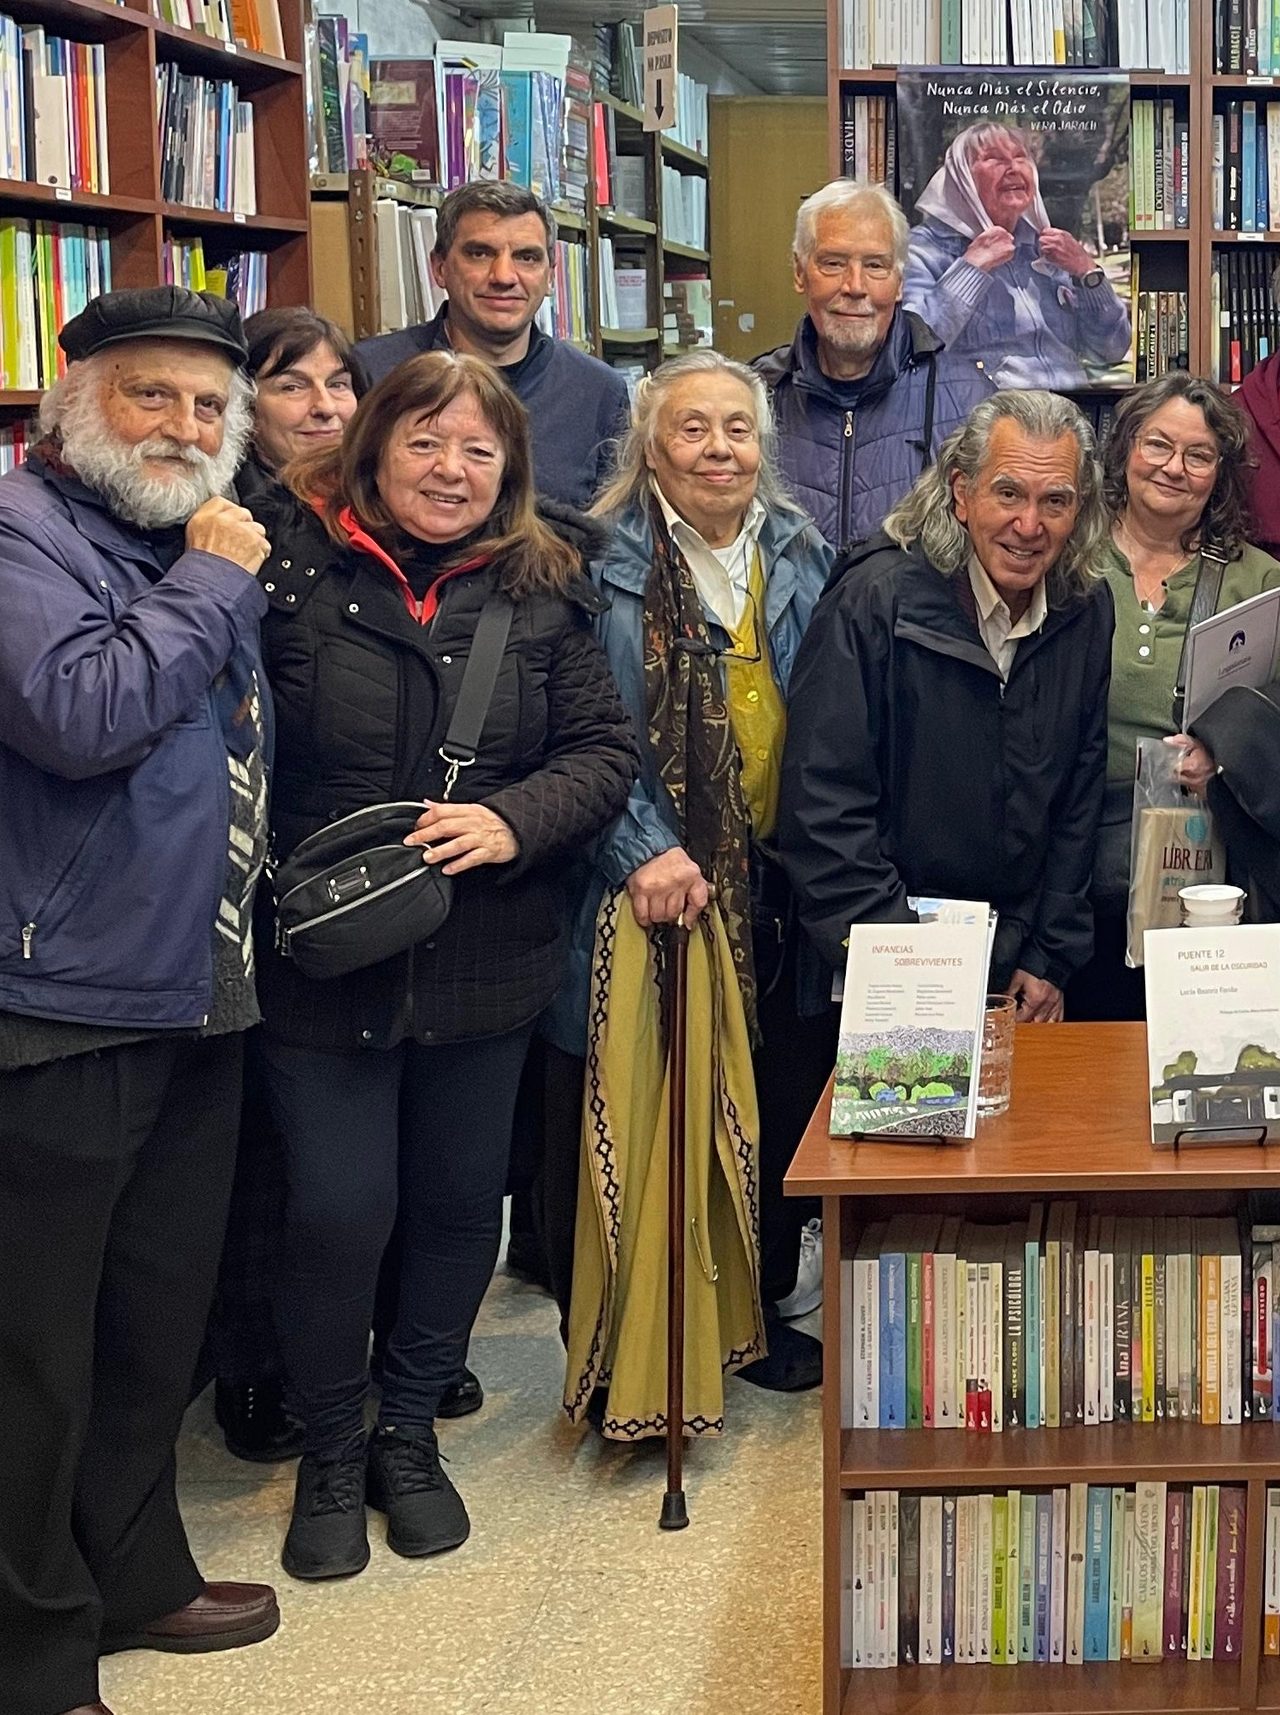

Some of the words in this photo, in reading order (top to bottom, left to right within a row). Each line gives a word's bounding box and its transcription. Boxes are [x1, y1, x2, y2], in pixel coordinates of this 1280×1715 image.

[927, 82, 973, 96] Nunca
[979, 80, 1010, 96] Más
[1017, 82, 1031, 96] el
[1036, 79, 1101, 97] Silencio,
[943, 101, 989, 115] Nunca
[995, 100, 1026, 115] Más
[1032, 101, 1047, 115] el
[1052, 100, 1087, 115] Odio
[1030, 120, 1056, 131] VERA
[1057, 120, 1097, 131] JARACH
[844, 120, 854, 162] HADES
[872, 945, 914, 954] INFANCIAS
[1178, 950, 1213, 960] PUENTE
[1216, 949, 1225, 958] 12
[894, 957, 963, 967] SOBREVIVIENTES
[1211, 963, 1219, 971] DE
[1221, 963, 1230, 971] LA
[1006, 1269, 1022, 1322] PSICÓLOGA
[1006, 1325, 1022, 1336] LA
[1150, 1504, 1158, 1533] VIENTO
[1139, 1564, 1148, 1604] CARLOS
